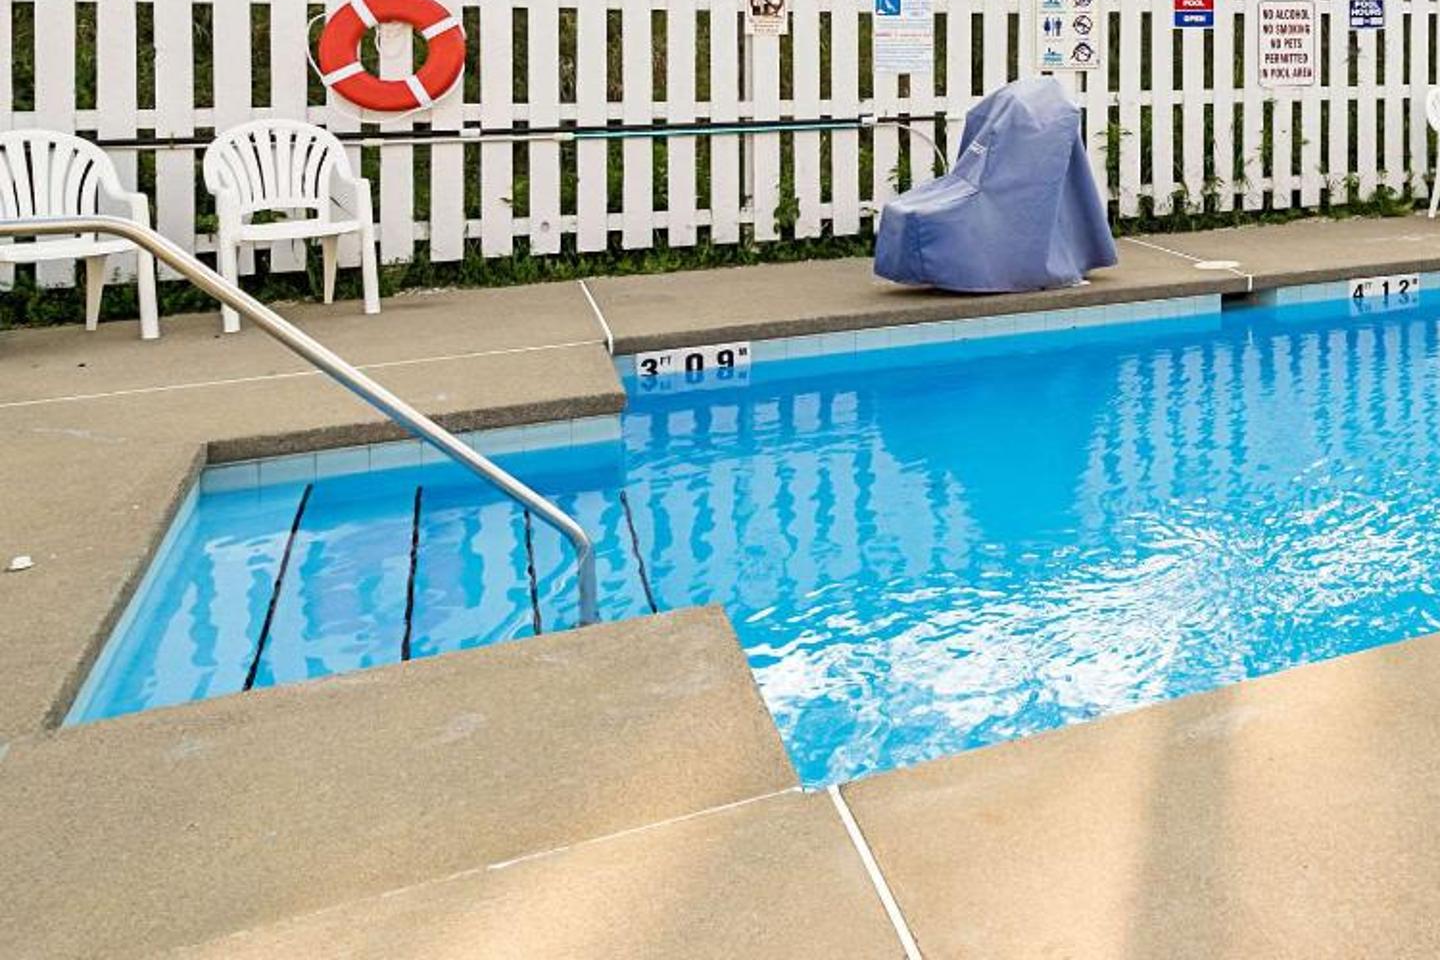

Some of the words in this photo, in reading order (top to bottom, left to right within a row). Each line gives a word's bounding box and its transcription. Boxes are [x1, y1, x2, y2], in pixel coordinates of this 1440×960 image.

[1182, 0, 1205, 7] POOL
[1263, 9, 1274, 20] NO
[1276, 9, 1310, 20] ALCOHOL
[1263, 24, 1274, 34] NO
[1276, 24, 1311, 35] SMOKING
[1271, 38, 1281, 49] NO
[1284, 38, 1302, 49] PETS
[1265, 53, 1308, 64] PERMITTED
[1271, 68, 1290, 79] POOL
[1293, 68, 1312, 78] AREA
